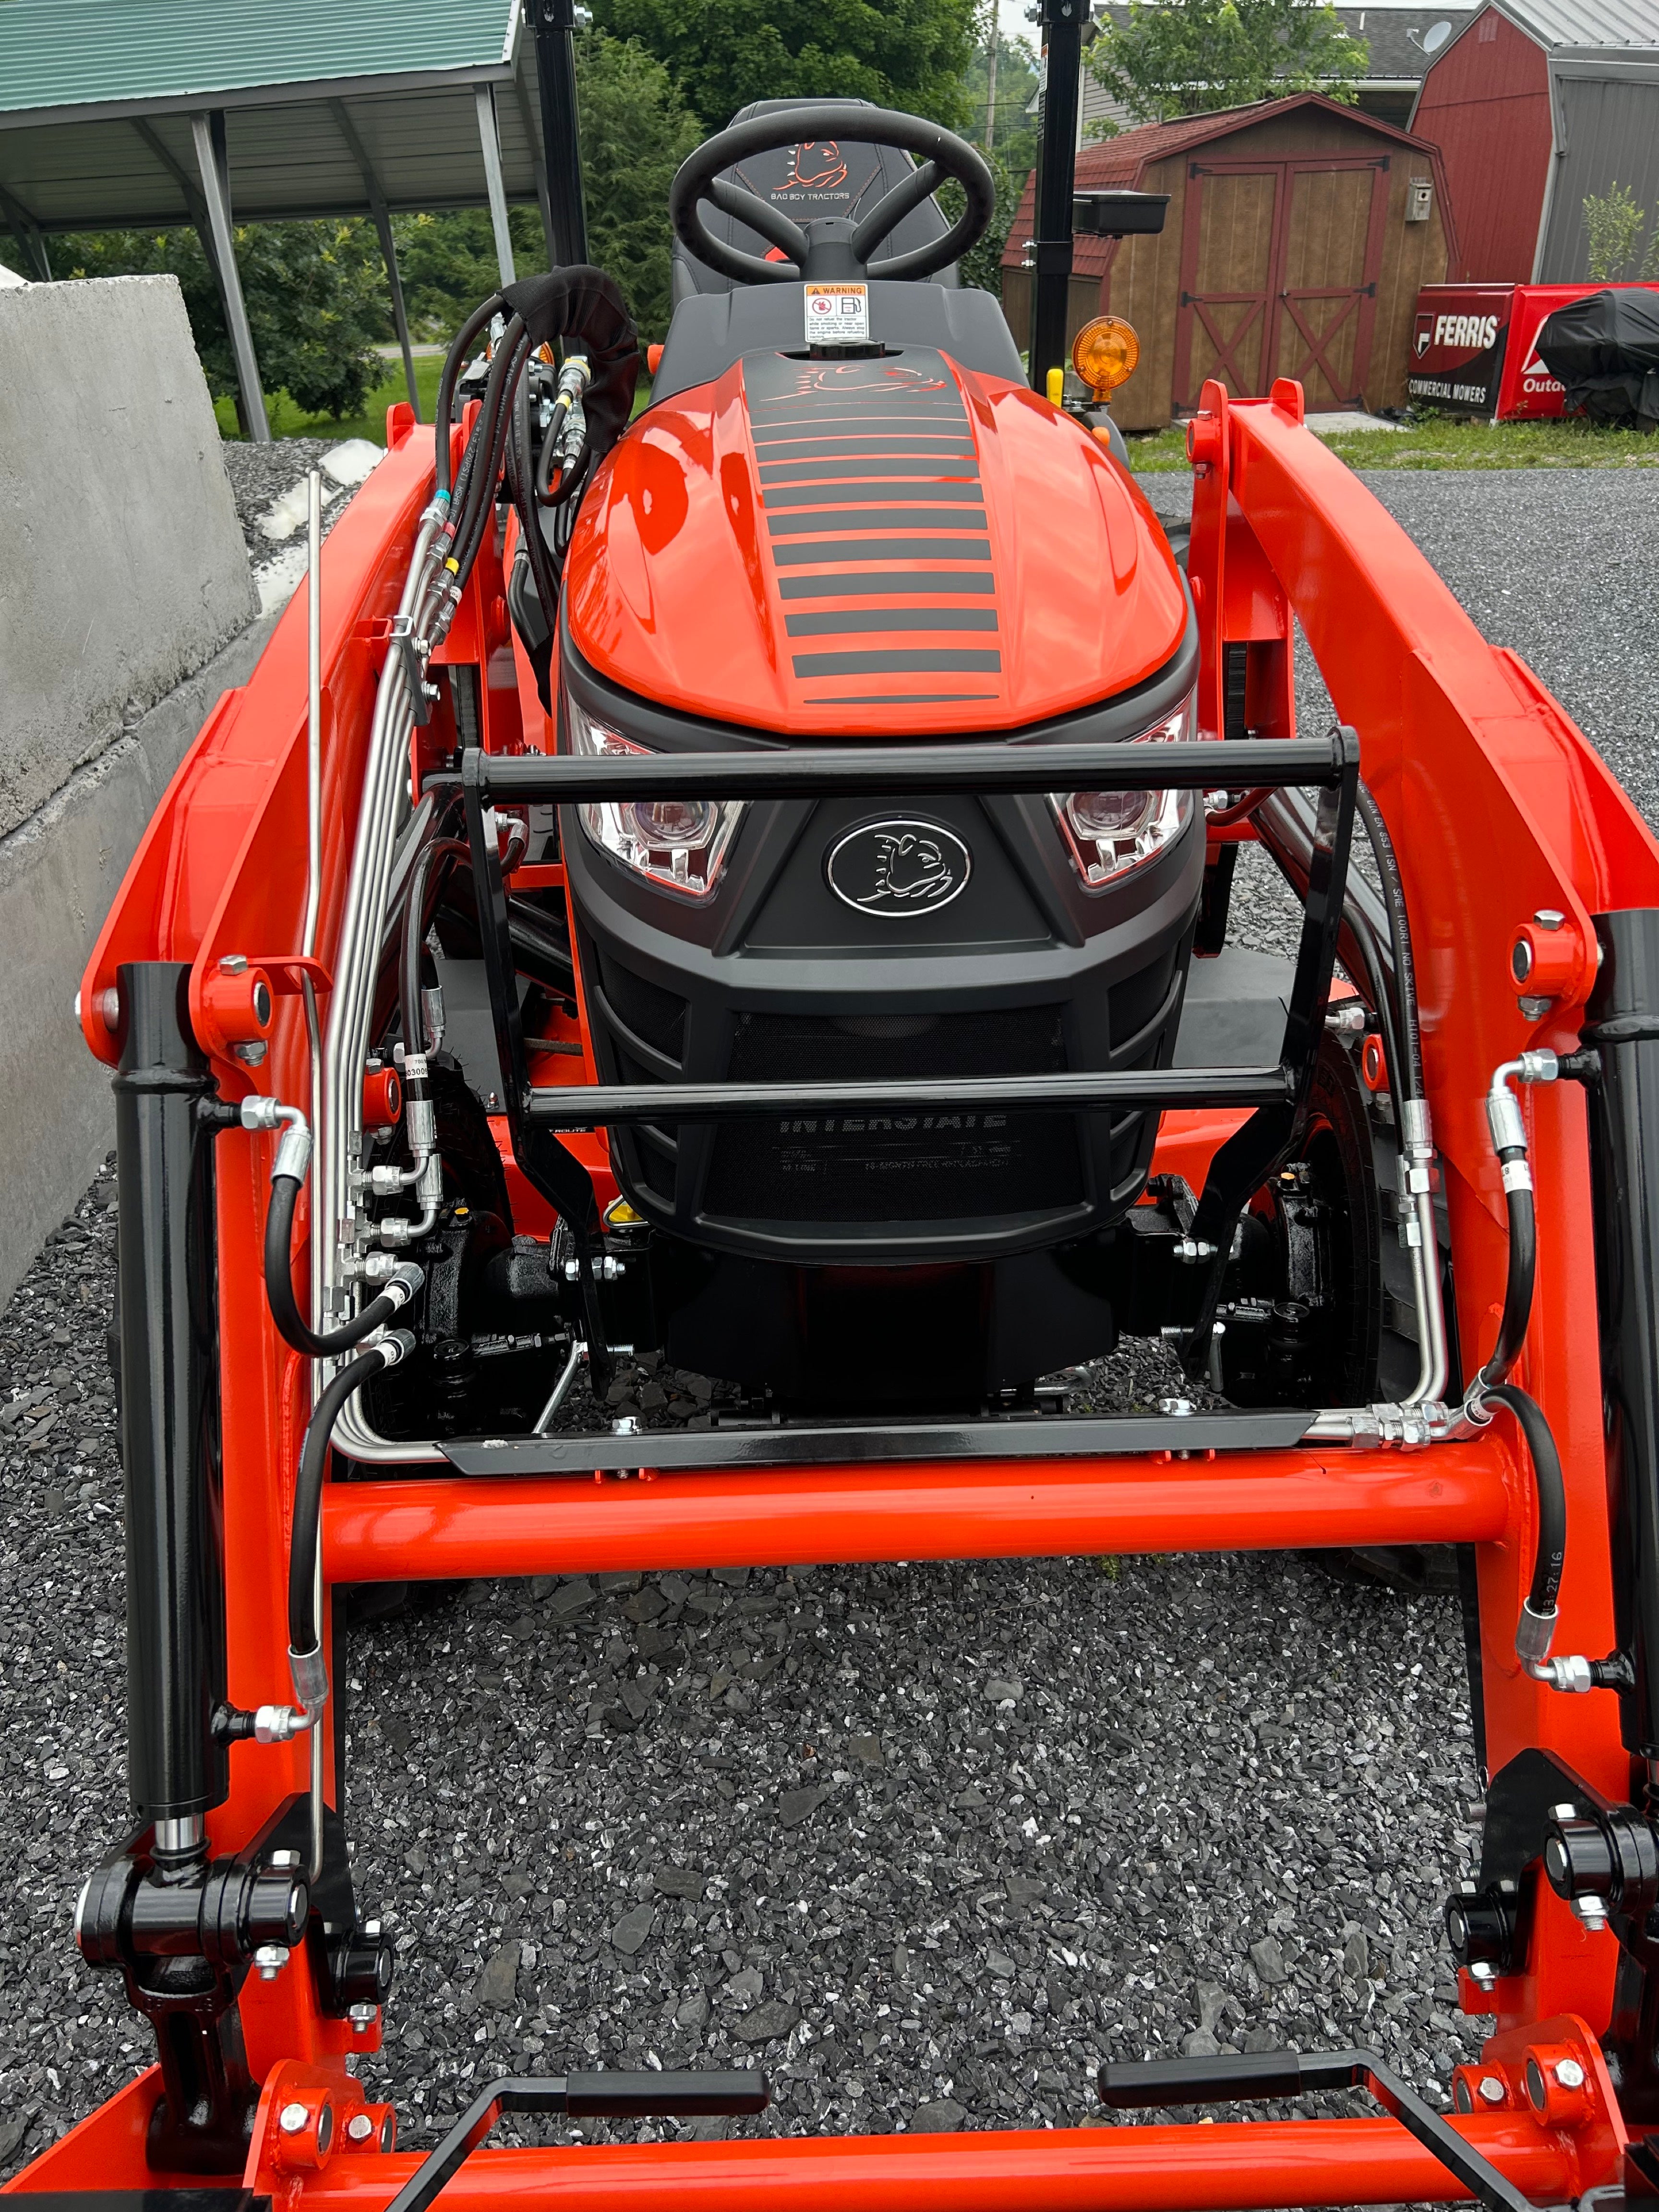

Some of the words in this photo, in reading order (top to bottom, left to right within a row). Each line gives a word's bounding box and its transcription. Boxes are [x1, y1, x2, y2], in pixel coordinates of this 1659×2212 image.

[1434, 315, 1498, 349] FERRIS
[1408, 379, 1452, 399] COMMERCIAL
[1452, 384, 1487, 404] MOWERS
[452, 485, 464, 505] MSHA
[1374, 817, 1385, 828] EN
[1379, 831, 1391, 848] 853
[1393, 888, 1404, 908] SAE
[1397, 914, 1410, 945] 100R1
[1401, 952, 1412, 966] NO
[1404, 972, 1416, 1007] SKIVE
[1408, 1019, 1422, 1067] H101-04
[1542, 1551, 1562, 1612] 13:27:16
